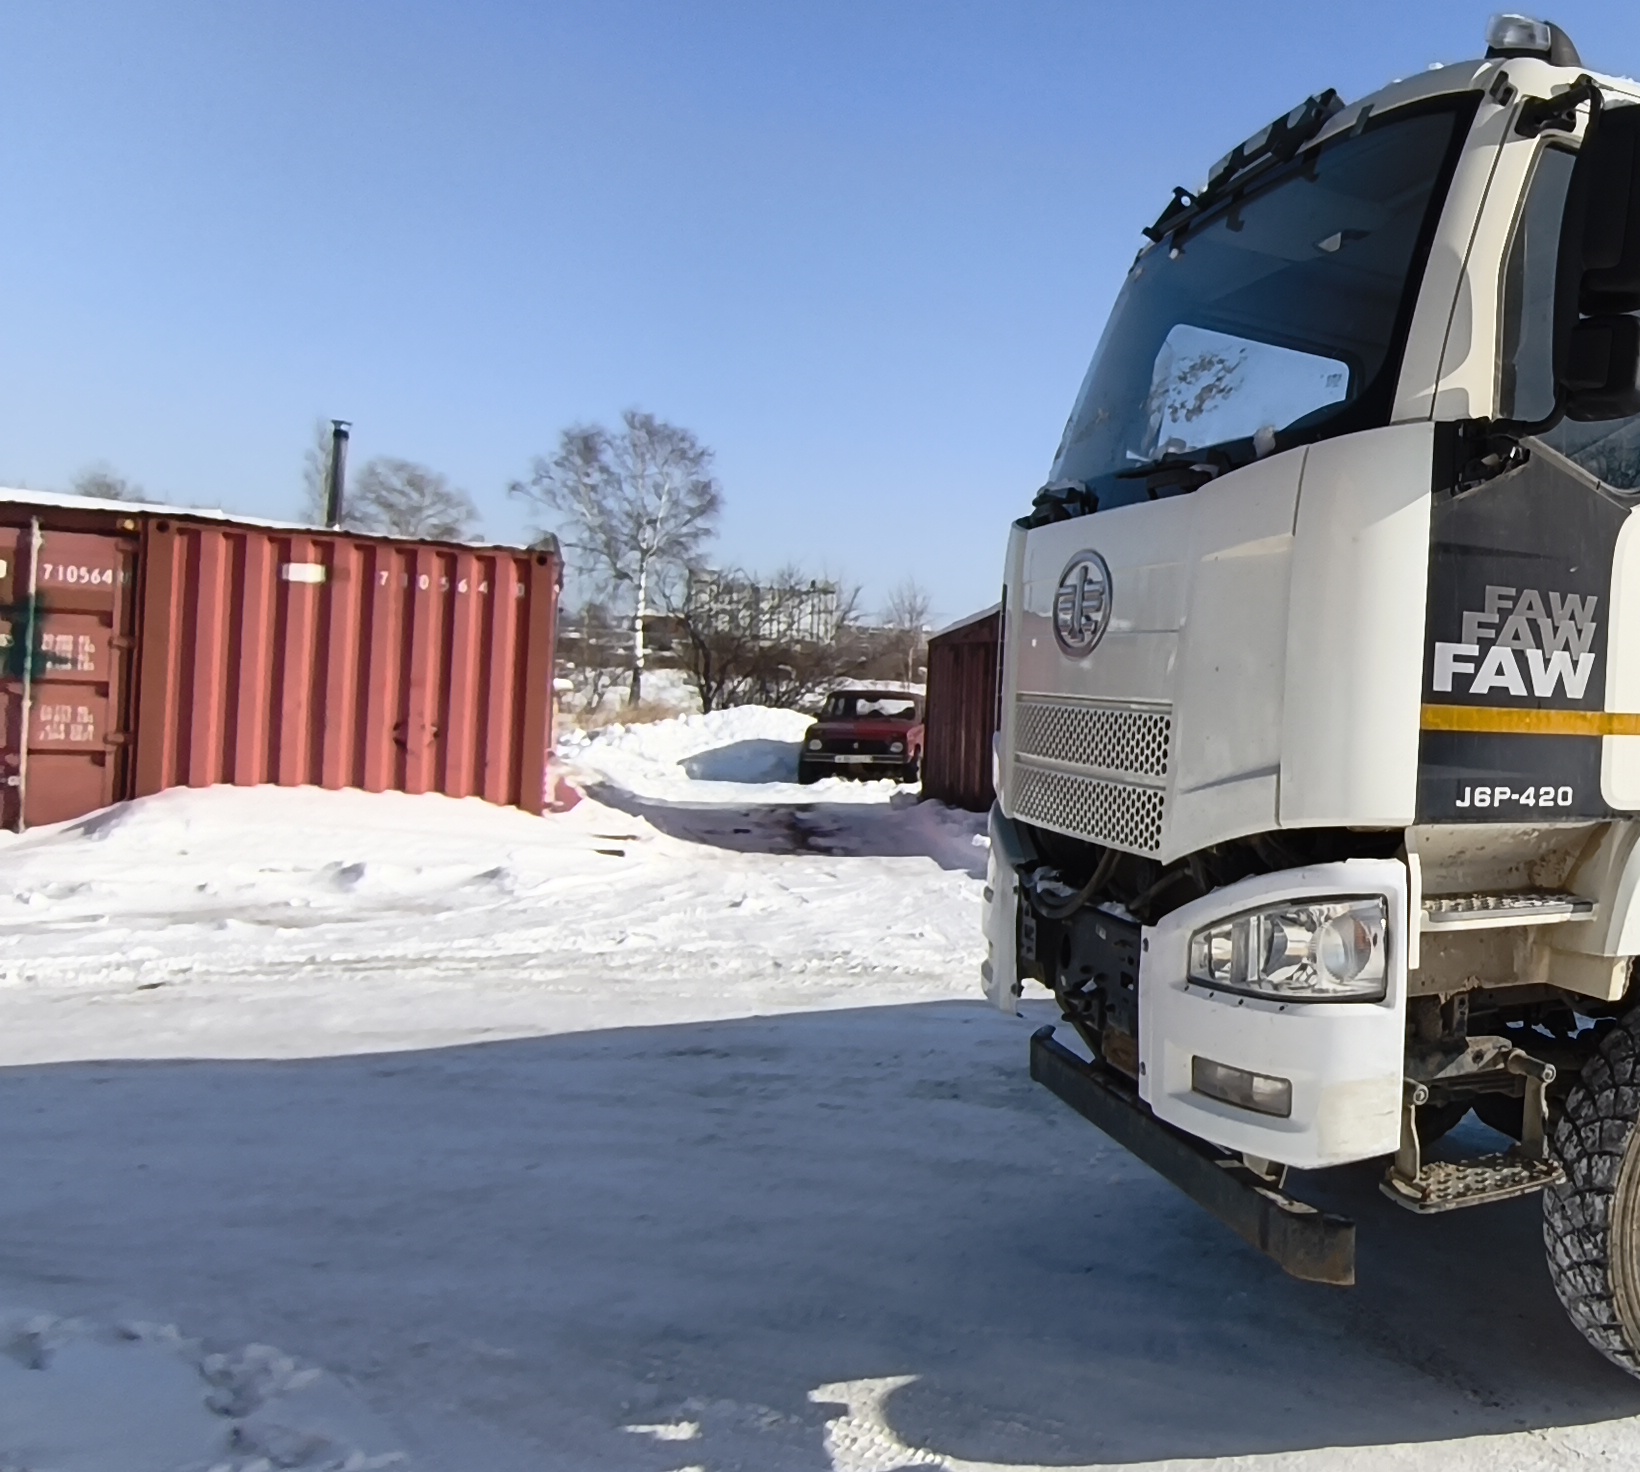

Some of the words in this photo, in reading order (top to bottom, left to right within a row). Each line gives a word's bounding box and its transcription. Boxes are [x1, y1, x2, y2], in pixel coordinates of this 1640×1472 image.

[43, 563, 113, 584] 710564
[1484, 585, 1598, 629] FAW
[1461, 611, 1597, 660] FAW
[1433, 641, 1596, 699] FAW
[1456, 786, 1573, 807] J6P-420
